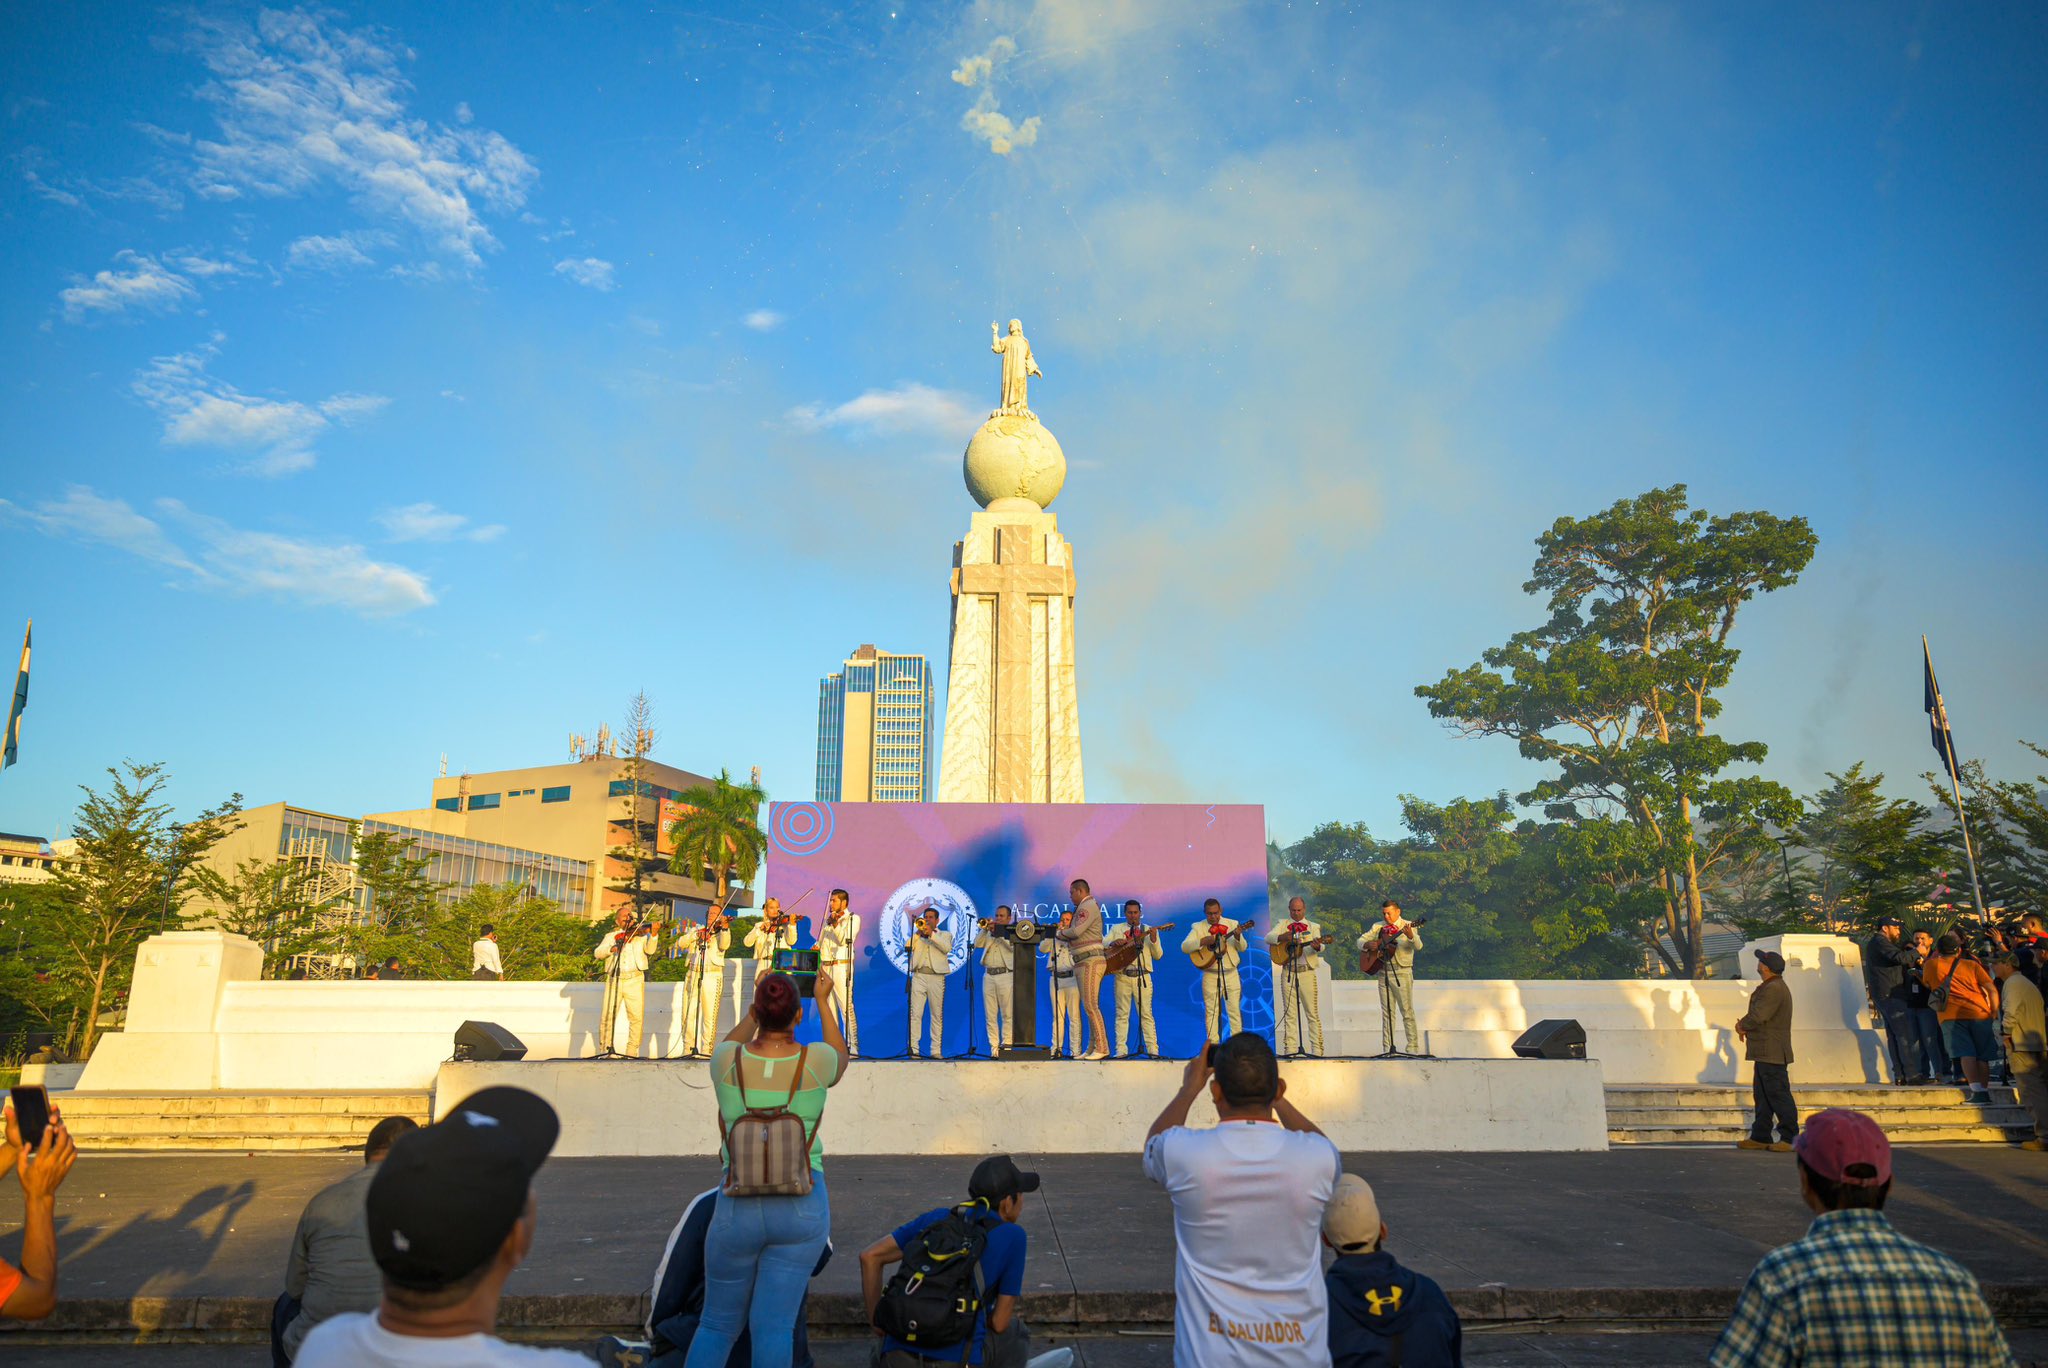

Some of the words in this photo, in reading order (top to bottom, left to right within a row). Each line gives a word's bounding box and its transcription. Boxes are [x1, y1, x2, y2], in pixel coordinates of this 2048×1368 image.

[1011, 903, 1111, 919] ALCAA
[1208, 1311, 1224, 1335] EL
[1228, 1319, 1306, 1344] SALVADOR
